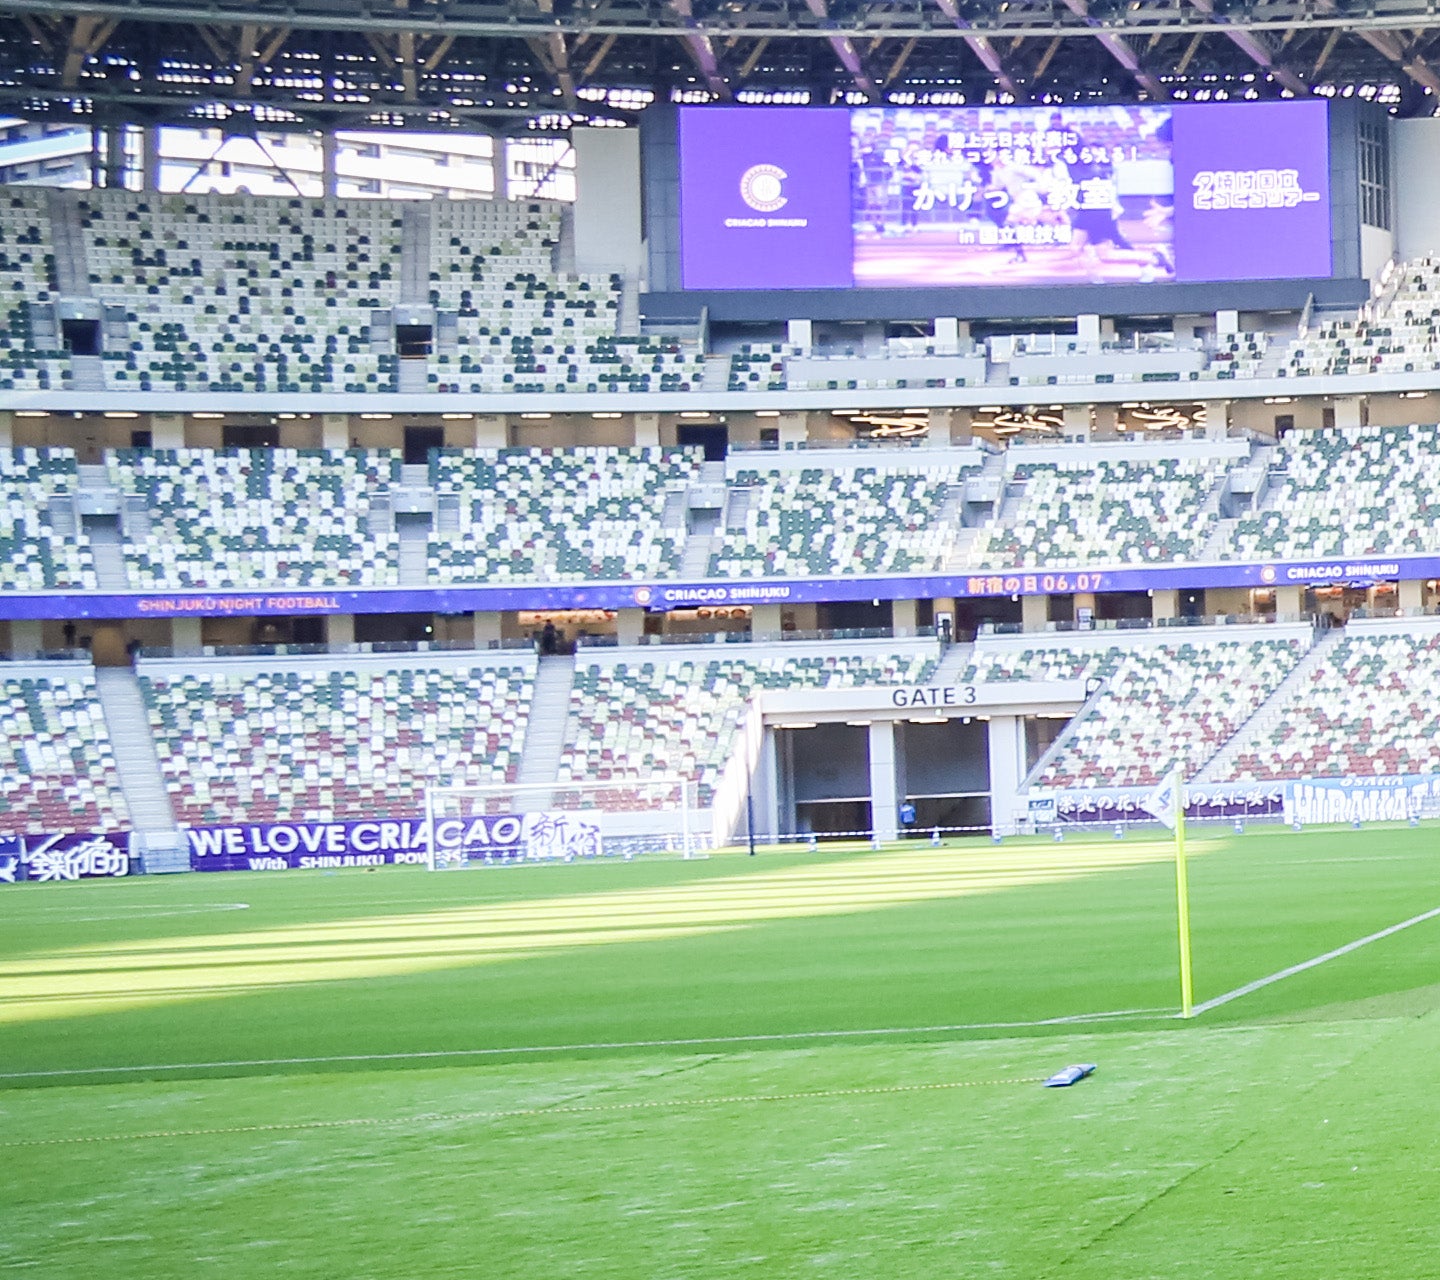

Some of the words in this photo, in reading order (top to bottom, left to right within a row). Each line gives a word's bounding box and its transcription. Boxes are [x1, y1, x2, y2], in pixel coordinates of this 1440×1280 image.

[959, 229, 975, 245] in
[1287, 566, 1343, 579] CRIACAO
[1345, 564, 1399, 577] SHINJUKU
[968, 576, 1038, 594] 新宿の日
[1043, 574, 1101, 591] 06.07
[665, 587, 727, 602] CRIACAO
[730, 585, 790, 599] SHINJUKU
[138, 597, 216, 612] SHINJUKU
[219, 597, 263, 610] NIGHT
[267, 596, 340, 609] FOOTBALL
[892, 686, 958, 709] GATE
[963, 685, 977, 707] 3
[1058, 787, 1282, 814] 栄光の花はの丘に咲く
[187, 826, 246, 857] WE
[251, 822, 346, 854] LOVE
[350, 817, 521, 852] CRIACAO
[249, 857, 288, 871] With
[299, 854, 385, 869] SHINJUKU
